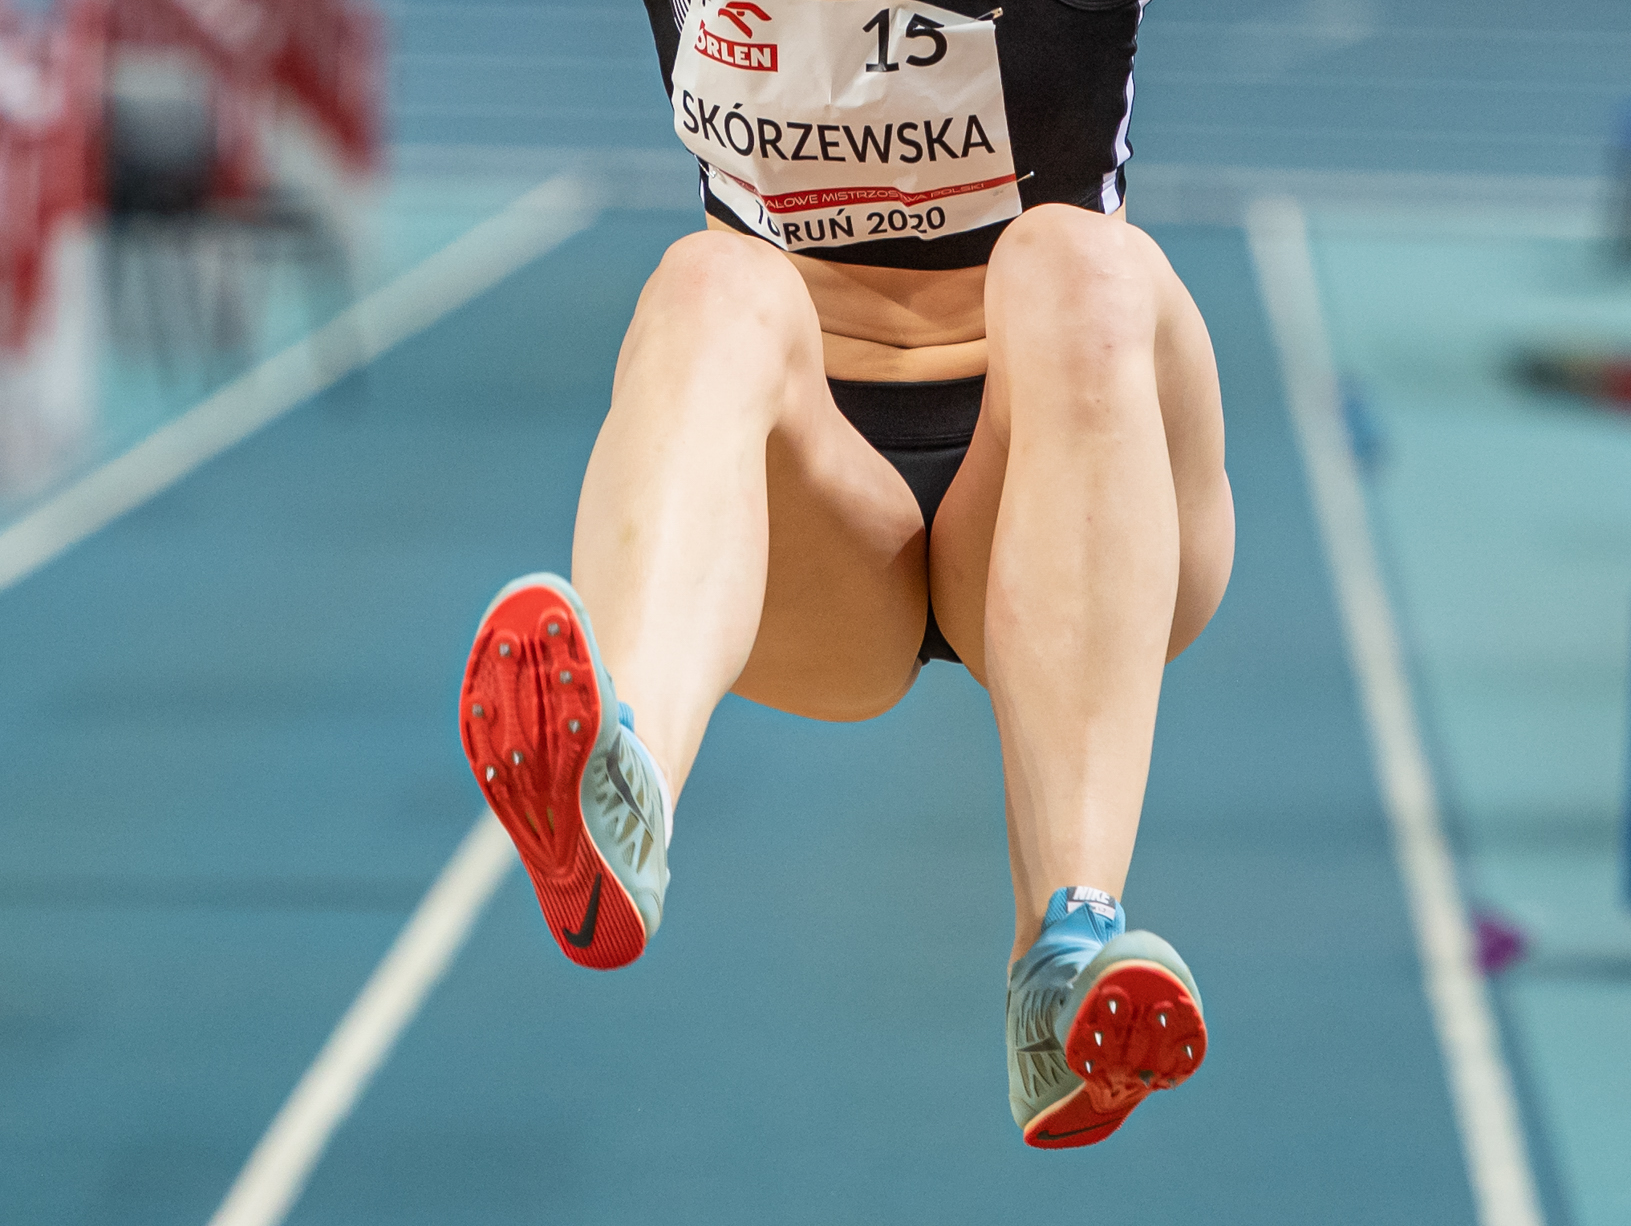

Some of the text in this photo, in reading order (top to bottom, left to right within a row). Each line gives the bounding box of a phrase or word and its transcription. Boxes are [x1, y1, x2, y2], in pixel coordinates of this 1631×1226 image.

[696, 28, 772, 68] ORLEN
[862, 8, 948, 73] 15
[682, 89, 995, 165] SKÓRZEWSKA
[763, 193, 819, 209] ALOWE
[930, 183, 985, 198] POLSKI
[866, 206, 946, 236] 2020
[1072, 886, 1111, 905] NIKE
